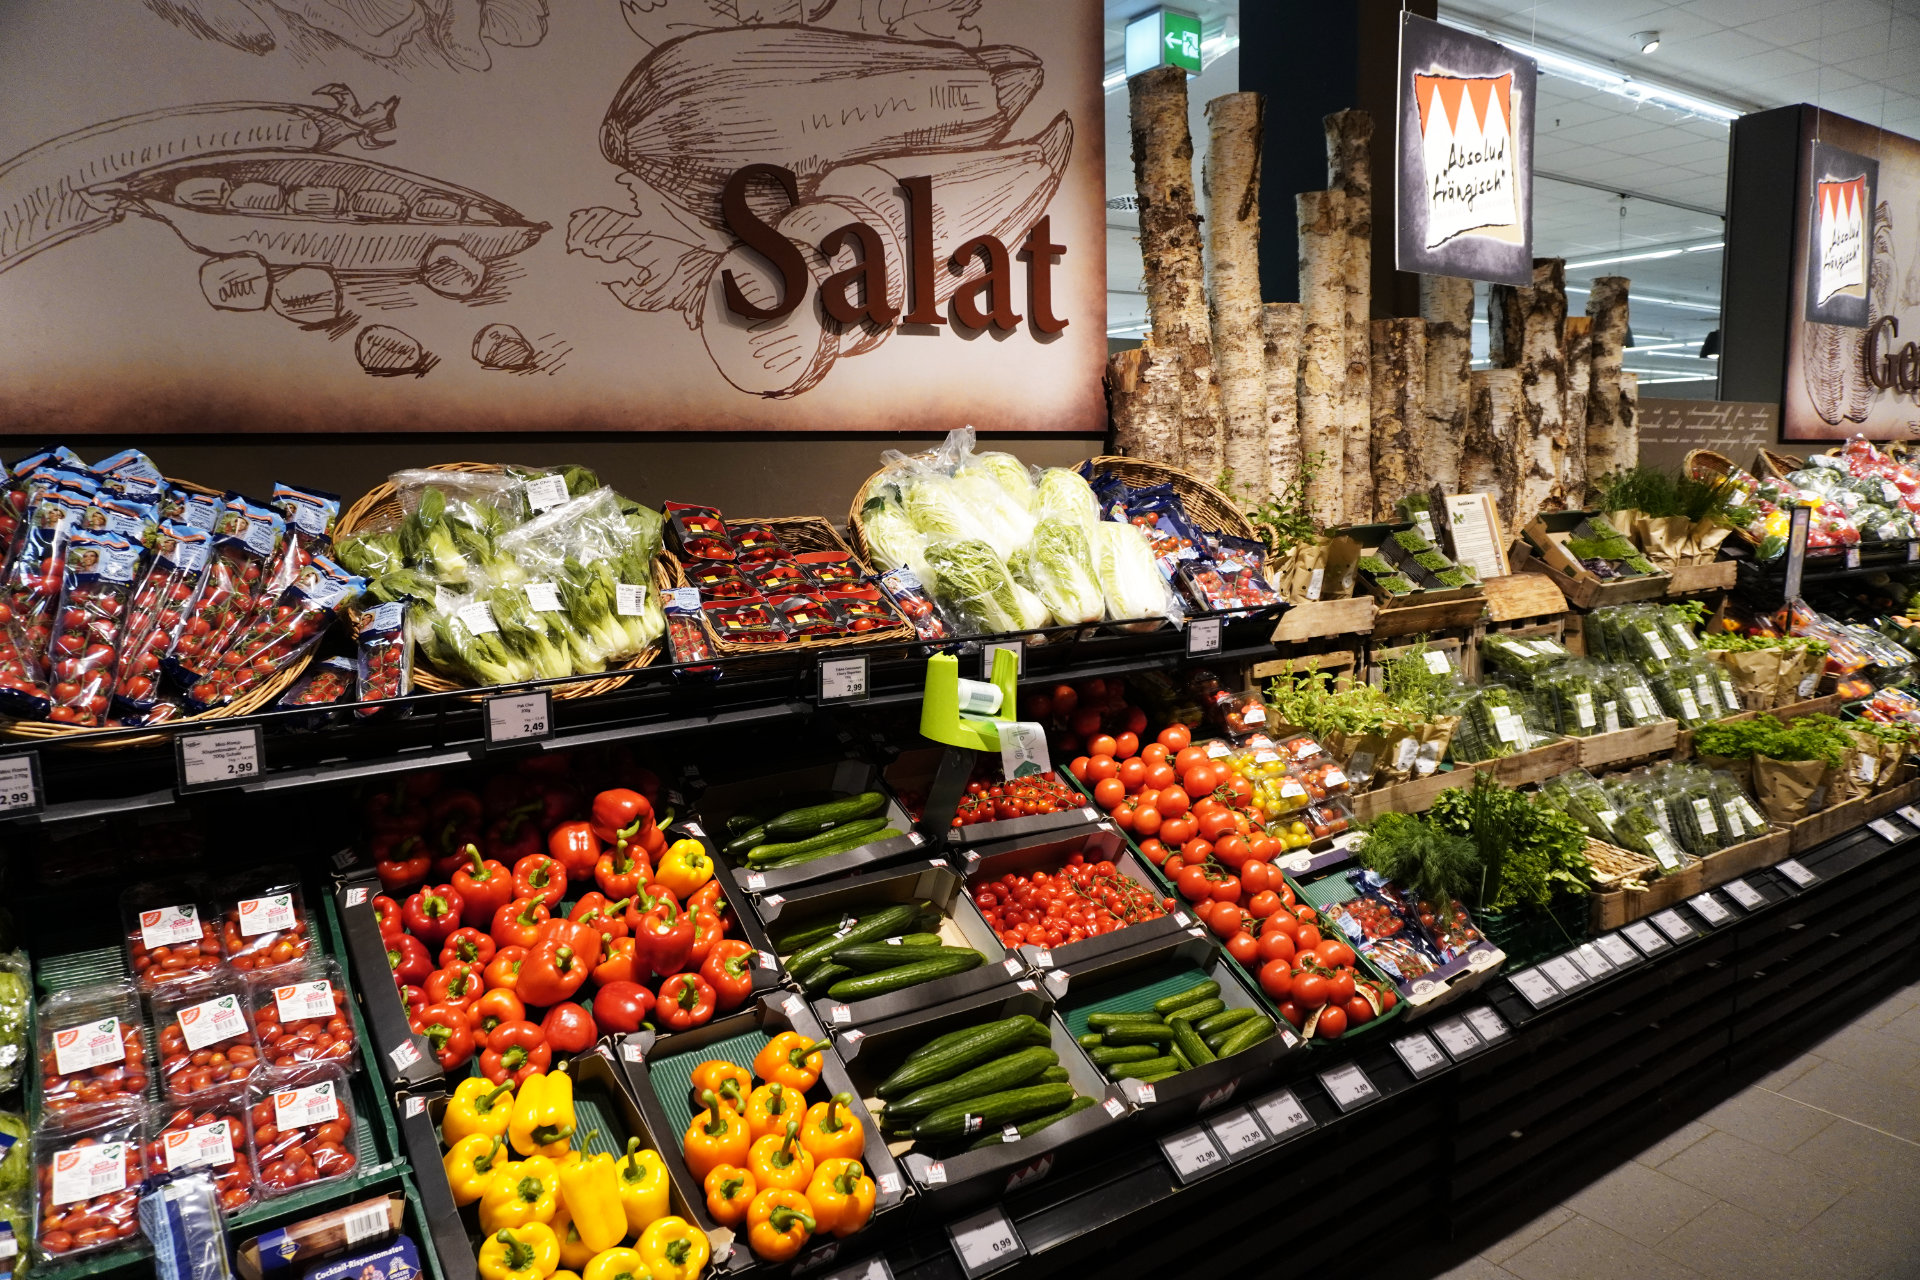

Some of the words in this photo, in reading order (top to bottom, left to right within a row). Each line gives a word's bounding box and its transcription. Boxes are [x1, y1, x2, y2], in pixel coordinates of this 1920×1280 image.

[721, 162, 1069, 334] Salat
[1868, 315, 1920, 390] Ge
[847, 683, 863, 693] 2,99
[524, 722, 544, 733] 2,49
[227, 762, 253, 775] 2,99
[0, 792, 29, 806] 2,99
[1354, 1083, 1368, 1094] 2,49
[1288, 1112, 1303, 1123] 9,90
[1241, 1131, 1261, 1144] 12,90
[1195, 1150, 1216, 1163] 12,90
[992, 1238, 1012, 1252] 0,99
[315, 1245, 404, 1280] Cocktail-Rispentomaten
